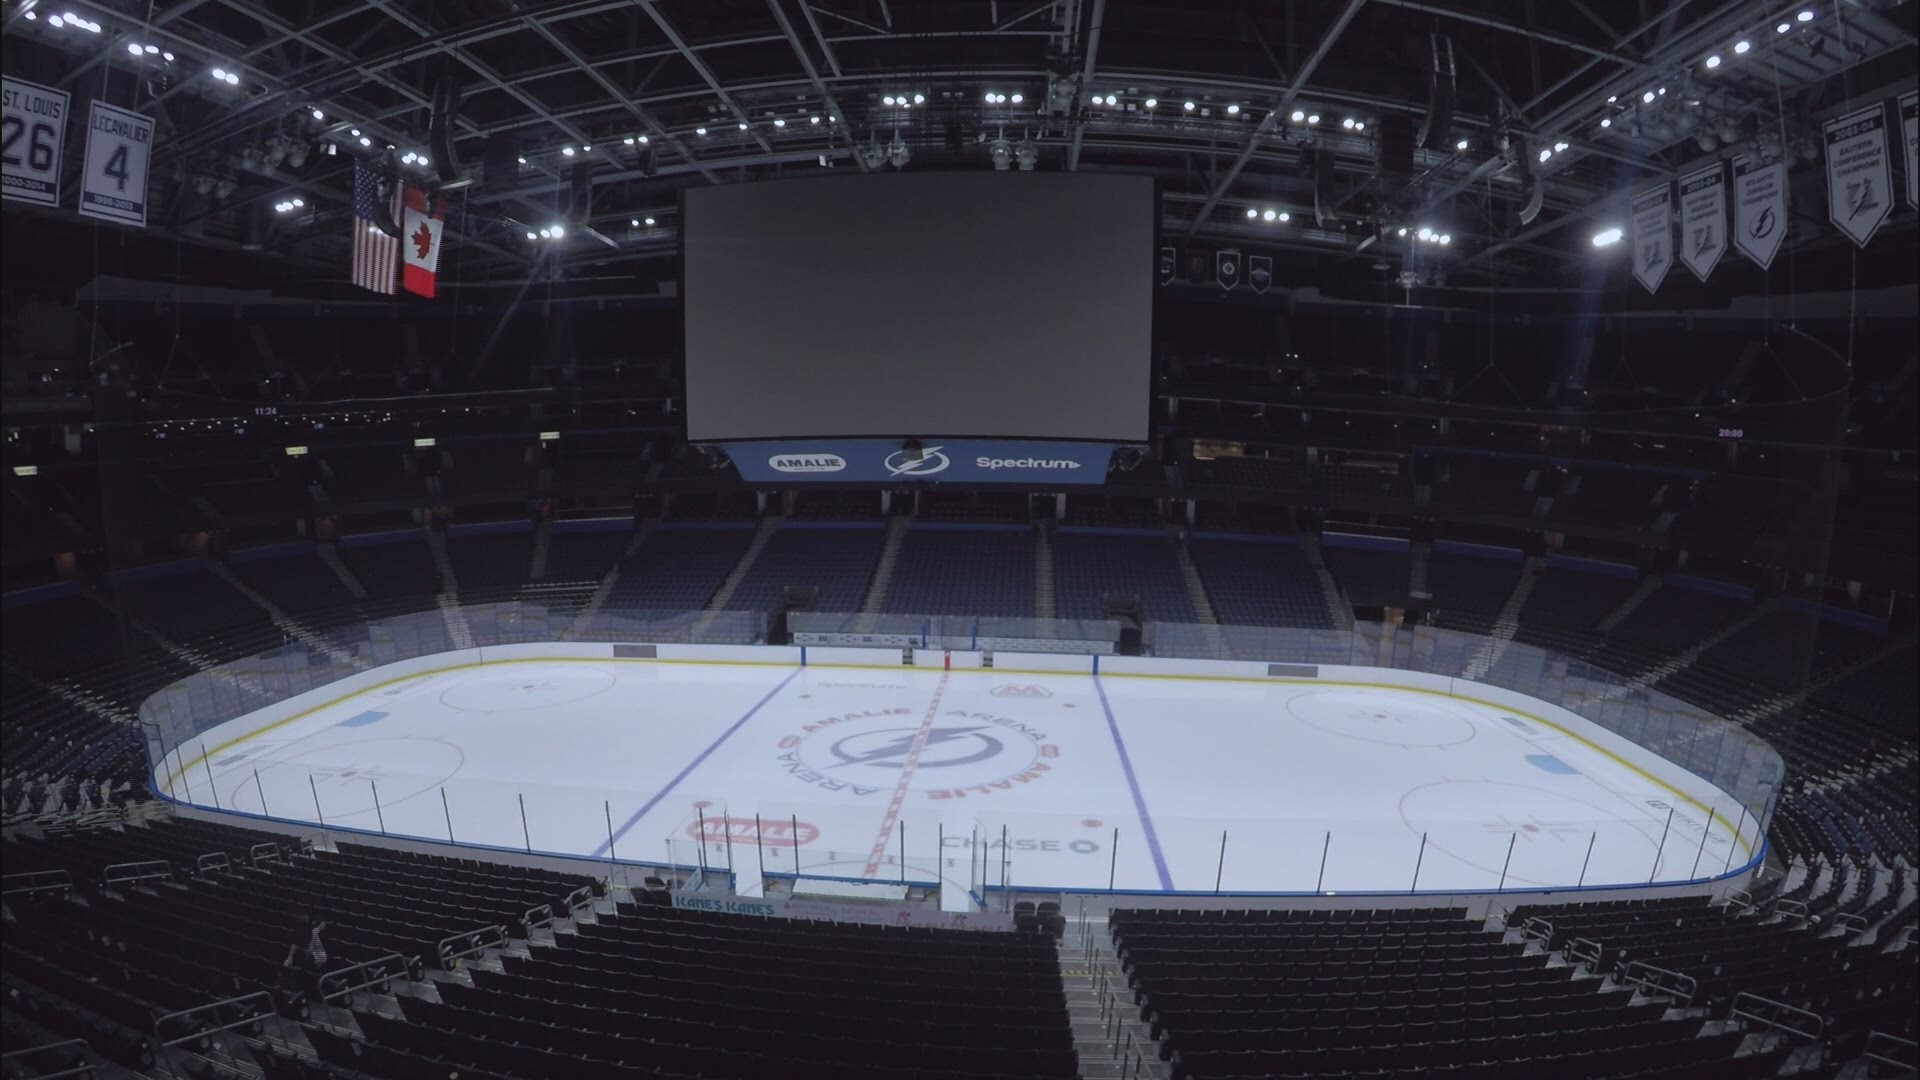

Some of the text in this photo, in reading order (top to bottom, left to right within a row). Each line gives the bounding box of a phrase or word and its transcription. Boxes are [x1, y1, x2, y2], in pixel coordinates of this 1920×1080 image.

[3, 89, 62, 119] ST. LOUIS
[94, 114, 149, 143] LECAVALIER
[1835, 120, 1875, 140] 2003-04
[2, 113, 55, 173] 26
[1840, 139, 1873, 156] EASTERN
[1833, 146, 1882, 168] CONFERENCE
[104, 144, 129, 192] 4
[1836, 159, 1880, 178] CHAMPIONS
[254, 407, 277, 416] 11:24
[1718, 428, 1744, 438] 20:00
[777, 459, 841, 468] AMALIE
[976, 456, 1076, 470] Spectrum
[801, 707, 1048, 742] AMALIE ARENA
[776, 751, 1053, 800] AMALIE ARENA
[942, 835, 1063, 853] CHASE
[675, 895, 724, 912] KANES
[726, 901, 777, 916] KANES
